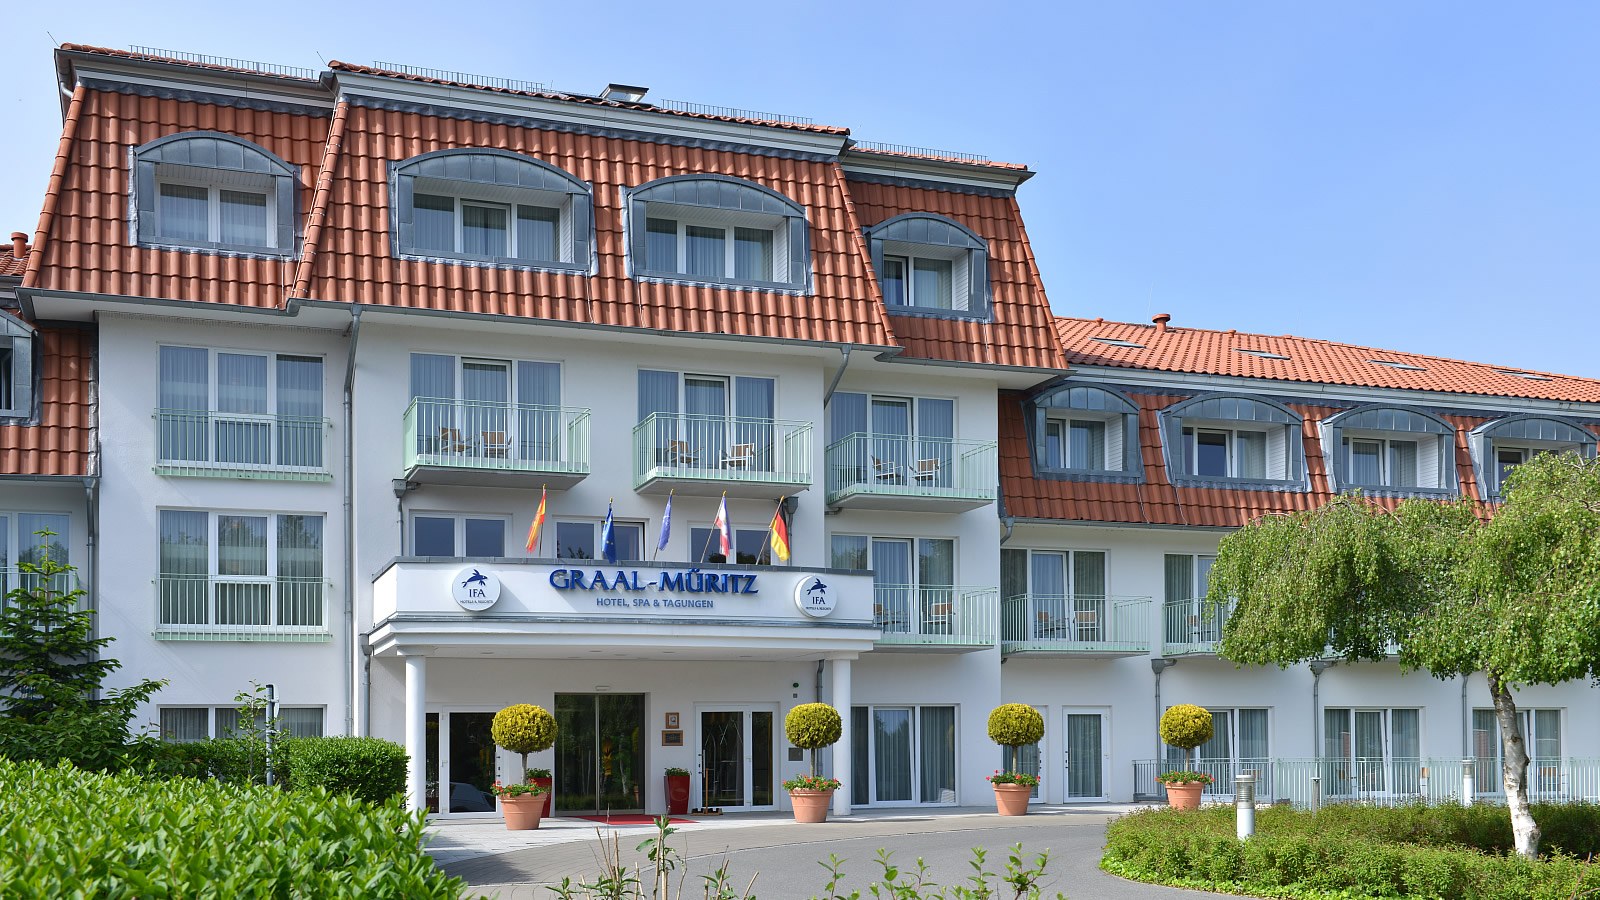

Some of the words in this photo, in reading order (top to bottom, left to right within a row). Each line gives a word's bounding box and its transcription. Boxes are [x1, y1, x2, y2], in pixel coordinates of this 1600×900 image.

[549, 568, 759, 594] GRAAL-MÜRITZ
[469, 588, 486, 598] IFA
[596, 598, 630, 608] HOTEL,
[632, 598, 651, 608] SPA
[653, 599, 660, 608] &
[662, 599, 714, 608] TAGUNGEN
[812, 596, 826, 605] IFA
